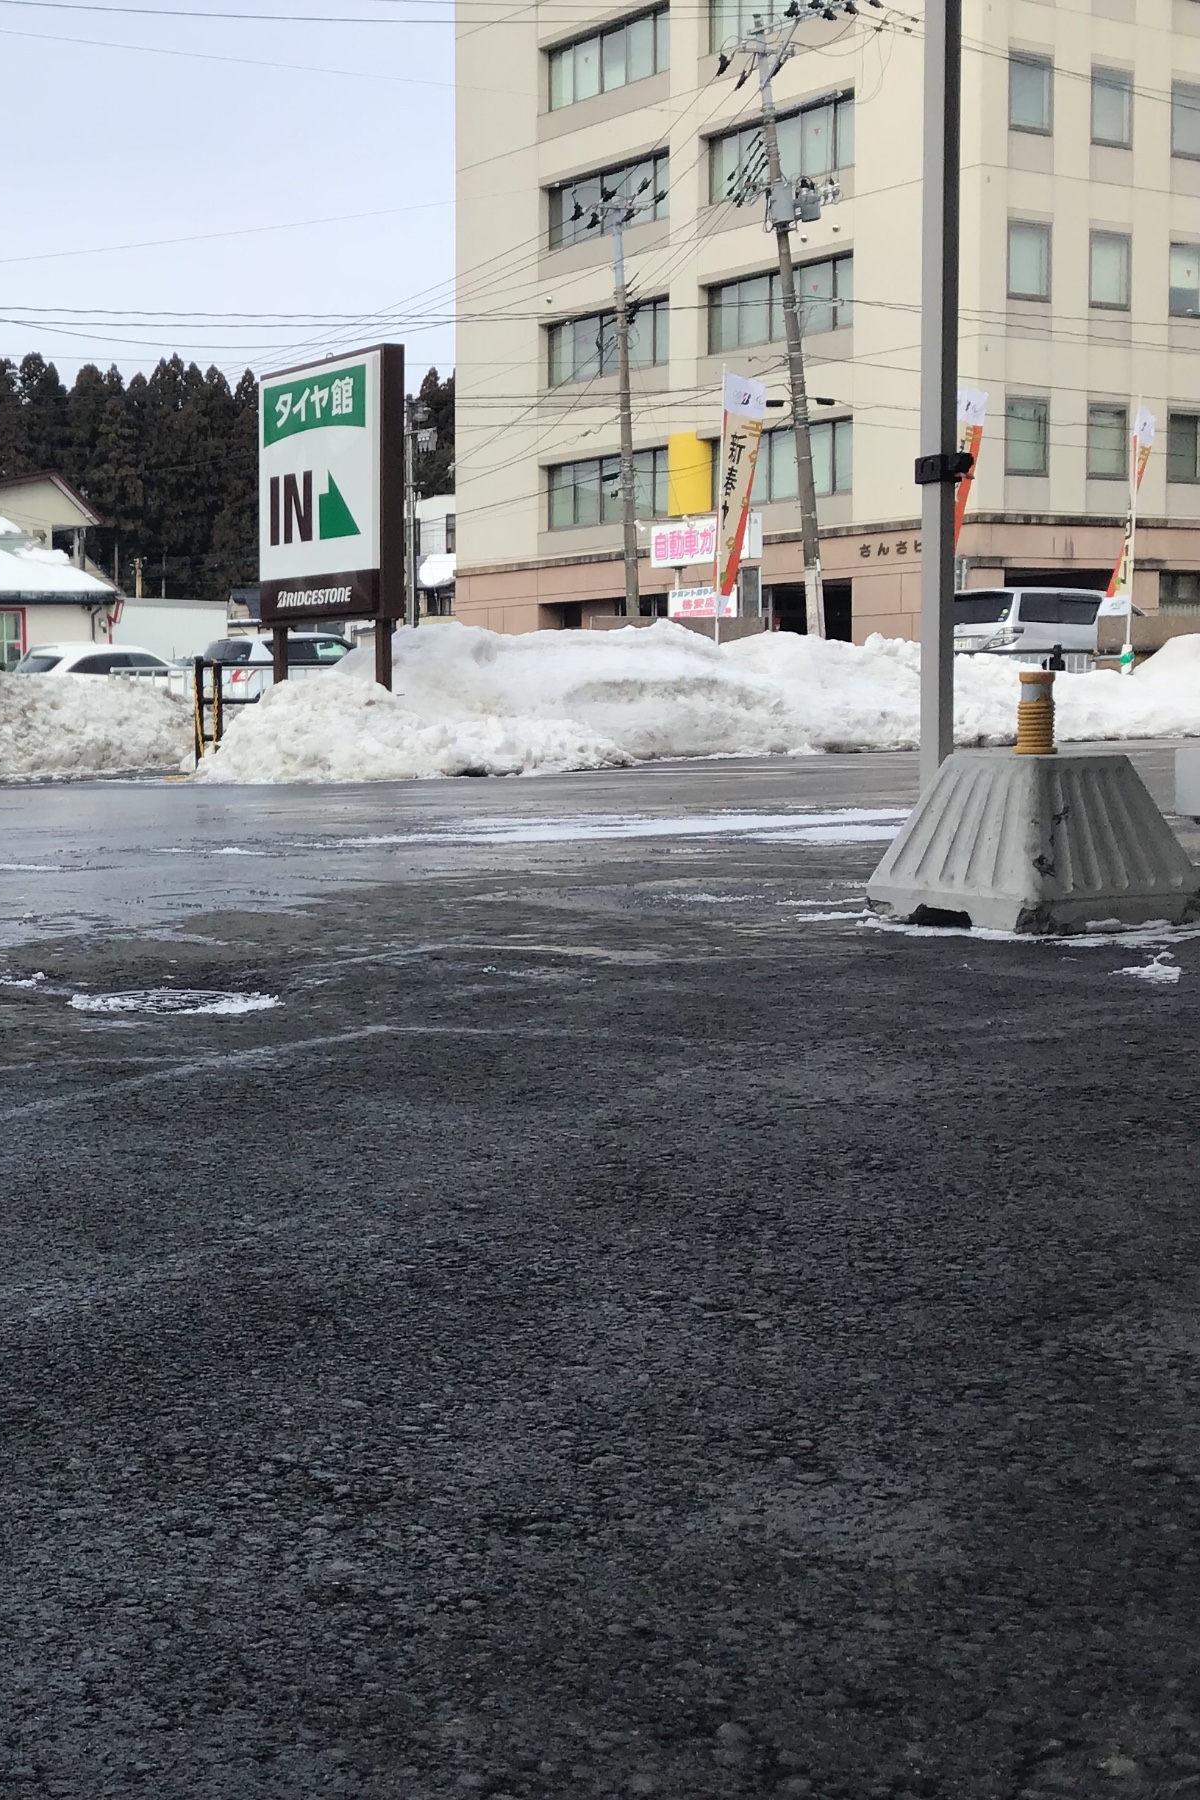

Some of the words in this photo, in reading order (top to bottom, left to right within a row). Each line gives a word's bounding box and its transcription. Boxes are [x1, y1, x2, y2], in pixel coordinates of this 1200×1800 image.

[274, 376, 354, 428] タイヤ館
[277, 586, 352, 608] BRIDGESTONE
